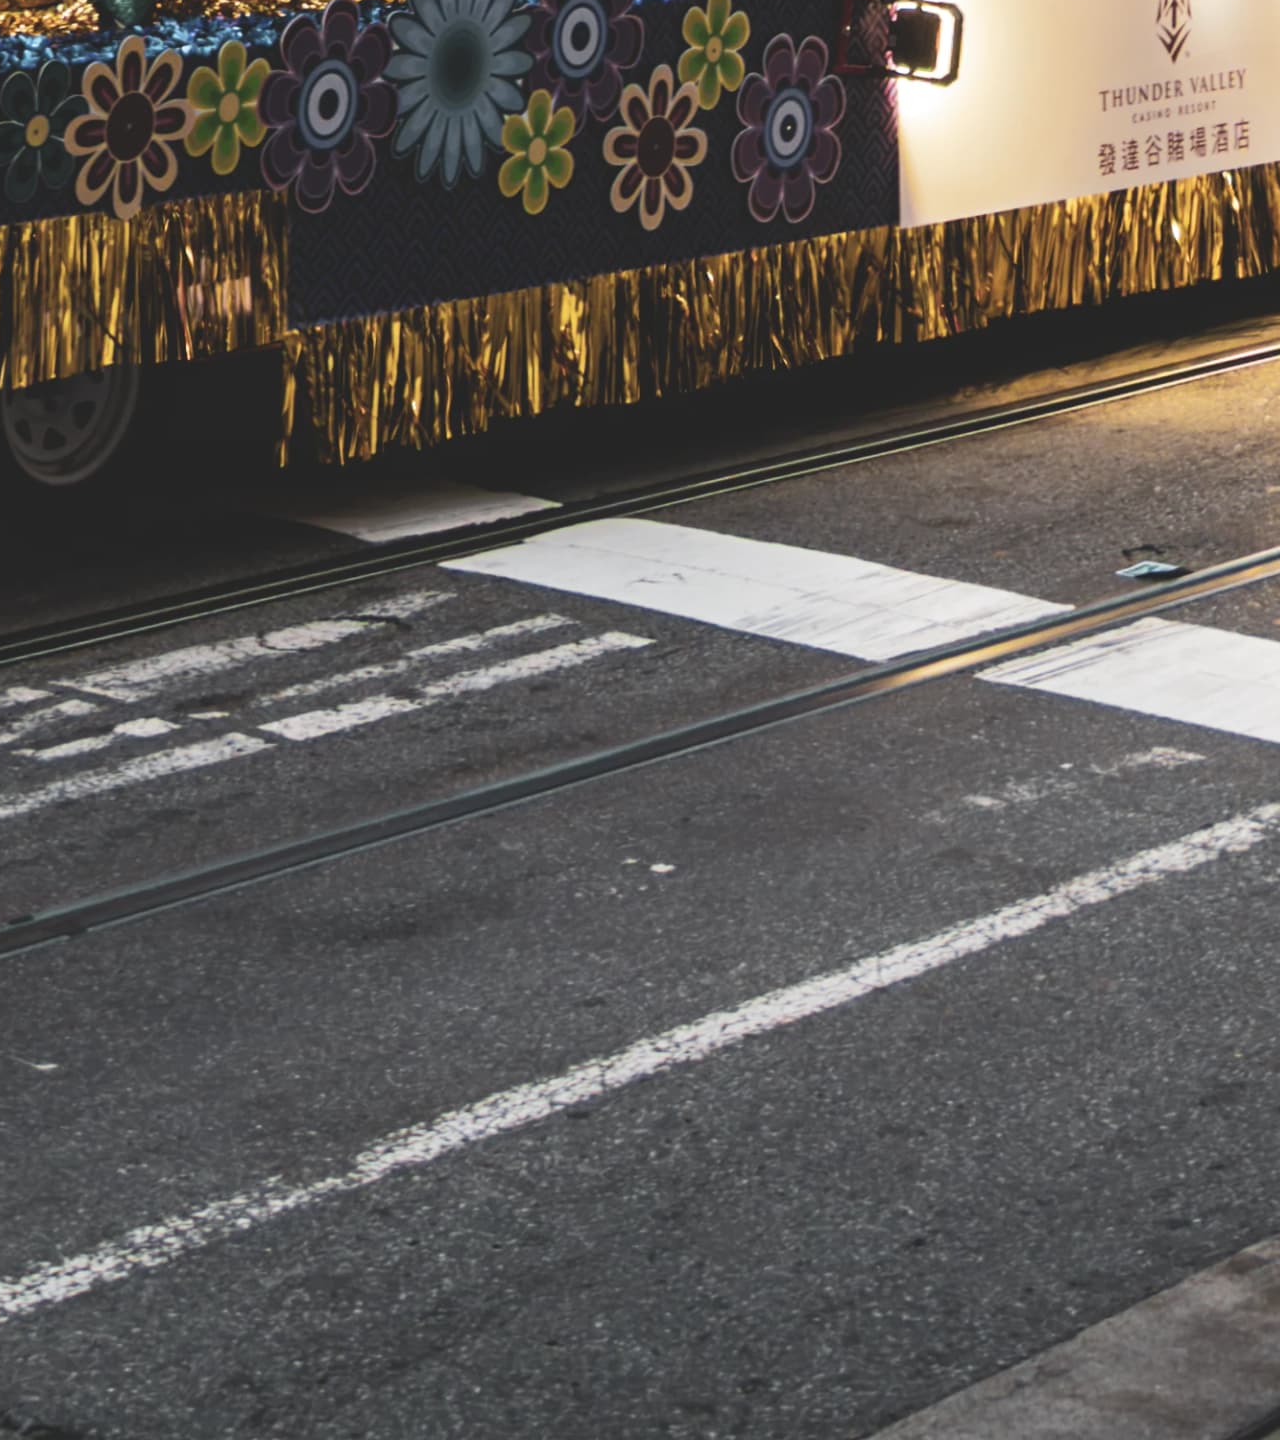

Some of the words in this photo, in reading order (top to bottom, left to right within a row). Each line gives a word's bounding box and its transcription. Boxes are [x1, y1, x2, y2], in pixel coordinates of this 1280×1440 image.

[1098, 79, 1184, 112] THUNDER
[1189, 68, 1247, 94] VALLEY
[1131, 107, 1171, 124] CASINO
[1178, 100, 1217, 116] RESORT
[1098, 118, 1250, 176] 發達谷賭場酒店
